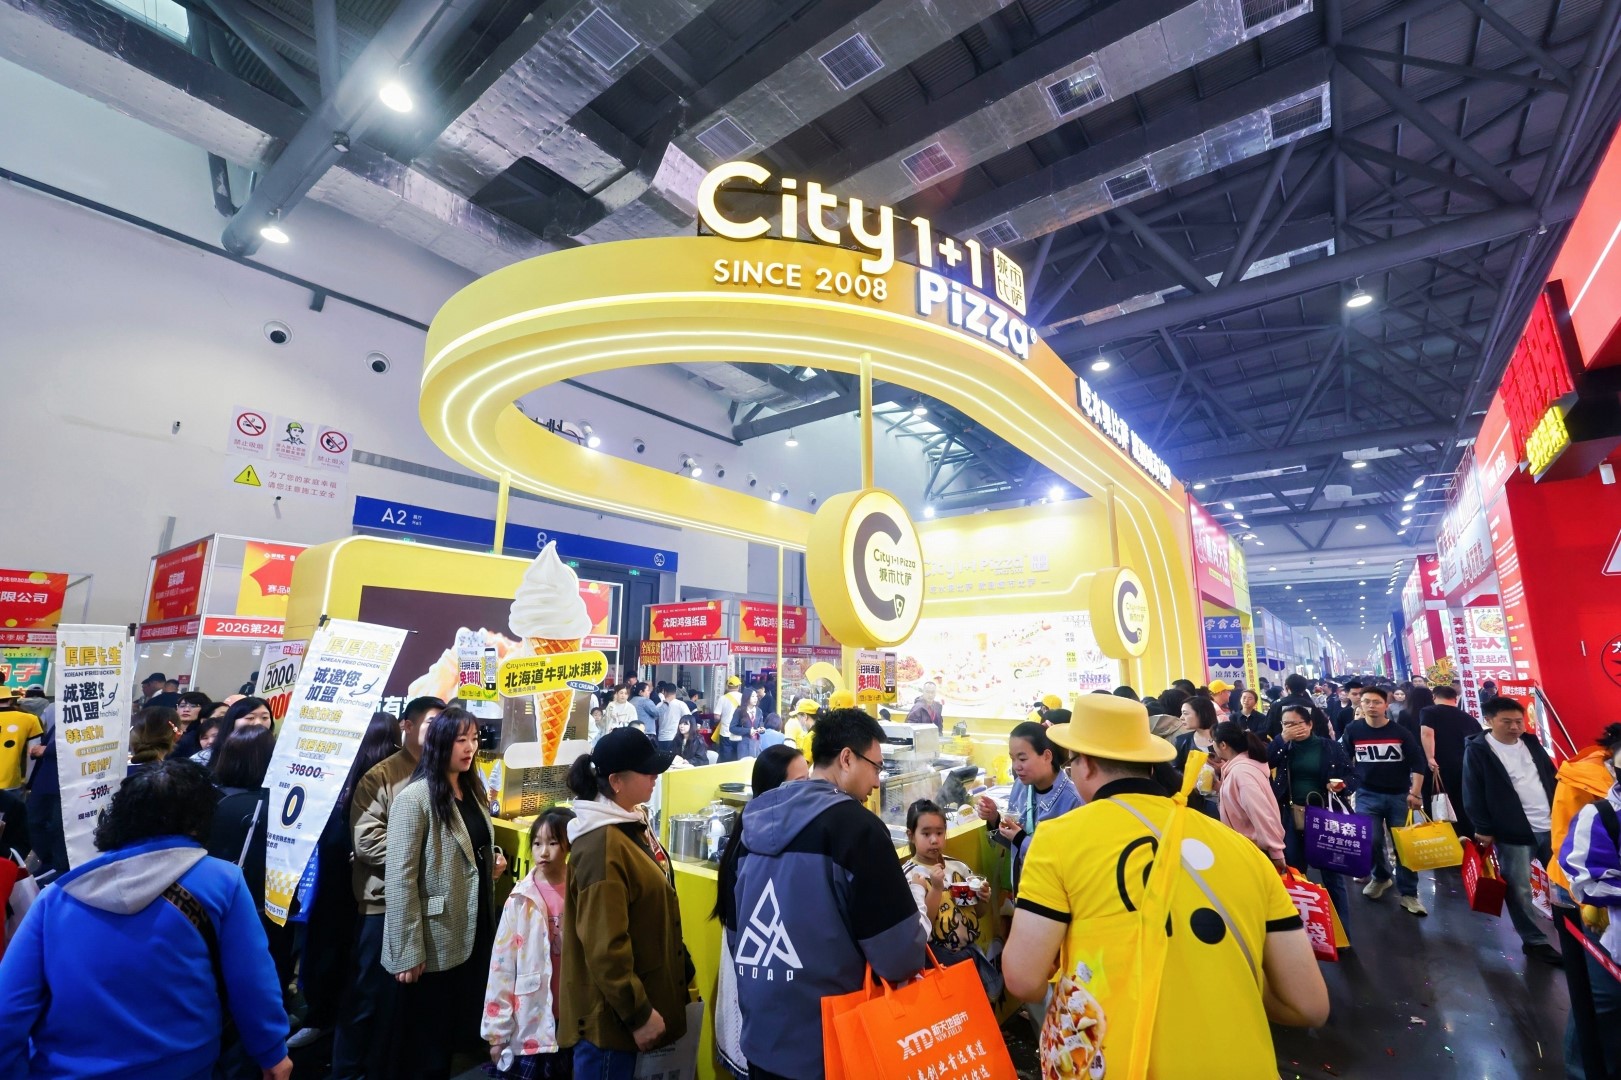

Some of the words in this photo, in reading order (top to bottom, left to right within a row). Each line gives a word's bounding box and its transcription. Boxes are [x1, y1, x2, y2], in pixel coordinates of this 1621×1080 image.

[697, 161, 894, 274] City
[911, 216, 984, 288] 1+1
[713, 259, 802, 290] SINCE
[815, 270, 888, 300] 2008
[919, 271, 1030, 359] Pizza
[234, 438, 263, 450] 禁止吸烟
[269, 471, 337, 489] 为了您的家庭幸福
[268, 481, 336, 499] 请您注意施工安全
[381, 507, 406, 526] A2
[536, 532, 547, 549] 8
[873, 548, 891, 567] City
[900, 557, 916, 569] Pizza
[879, 567, 912, 586] 城市比萨
[0, 591, 48, 603] 限公司
[662, 615, 707, 628] 沈阳鸿强纸品
[324, 636, 396, 663] 厚厚先生
[662, 640, 728, 663] 沈阳不干胶源头工厂
[357, 661, 380, 669] CHICKEN
[505, 660, 603, 688] 北海道牛乳冰淇淋
[264, 663, 294, 691] 2000
[313, 666, 362, 687] 诚邀您
[460, 671, 482, 687] 免排队
[578, 682, 595, 690] CREAM
[858, 675, 881, 691] 免排队
[305, 684, 339, 703] 加盟
[63, 701, 99, 723] 加盟
[1356, 745, 1401, 761] FILA
[1318, 834, 1361, 849] 广告宣传袋
[930, 1011, 969, 1036] 新天地超市
[935, 1033, 948, 1042] NEW
[947, 1025, 963, 1038] FIELD
[896, 1028, 934, 1060] XTD
